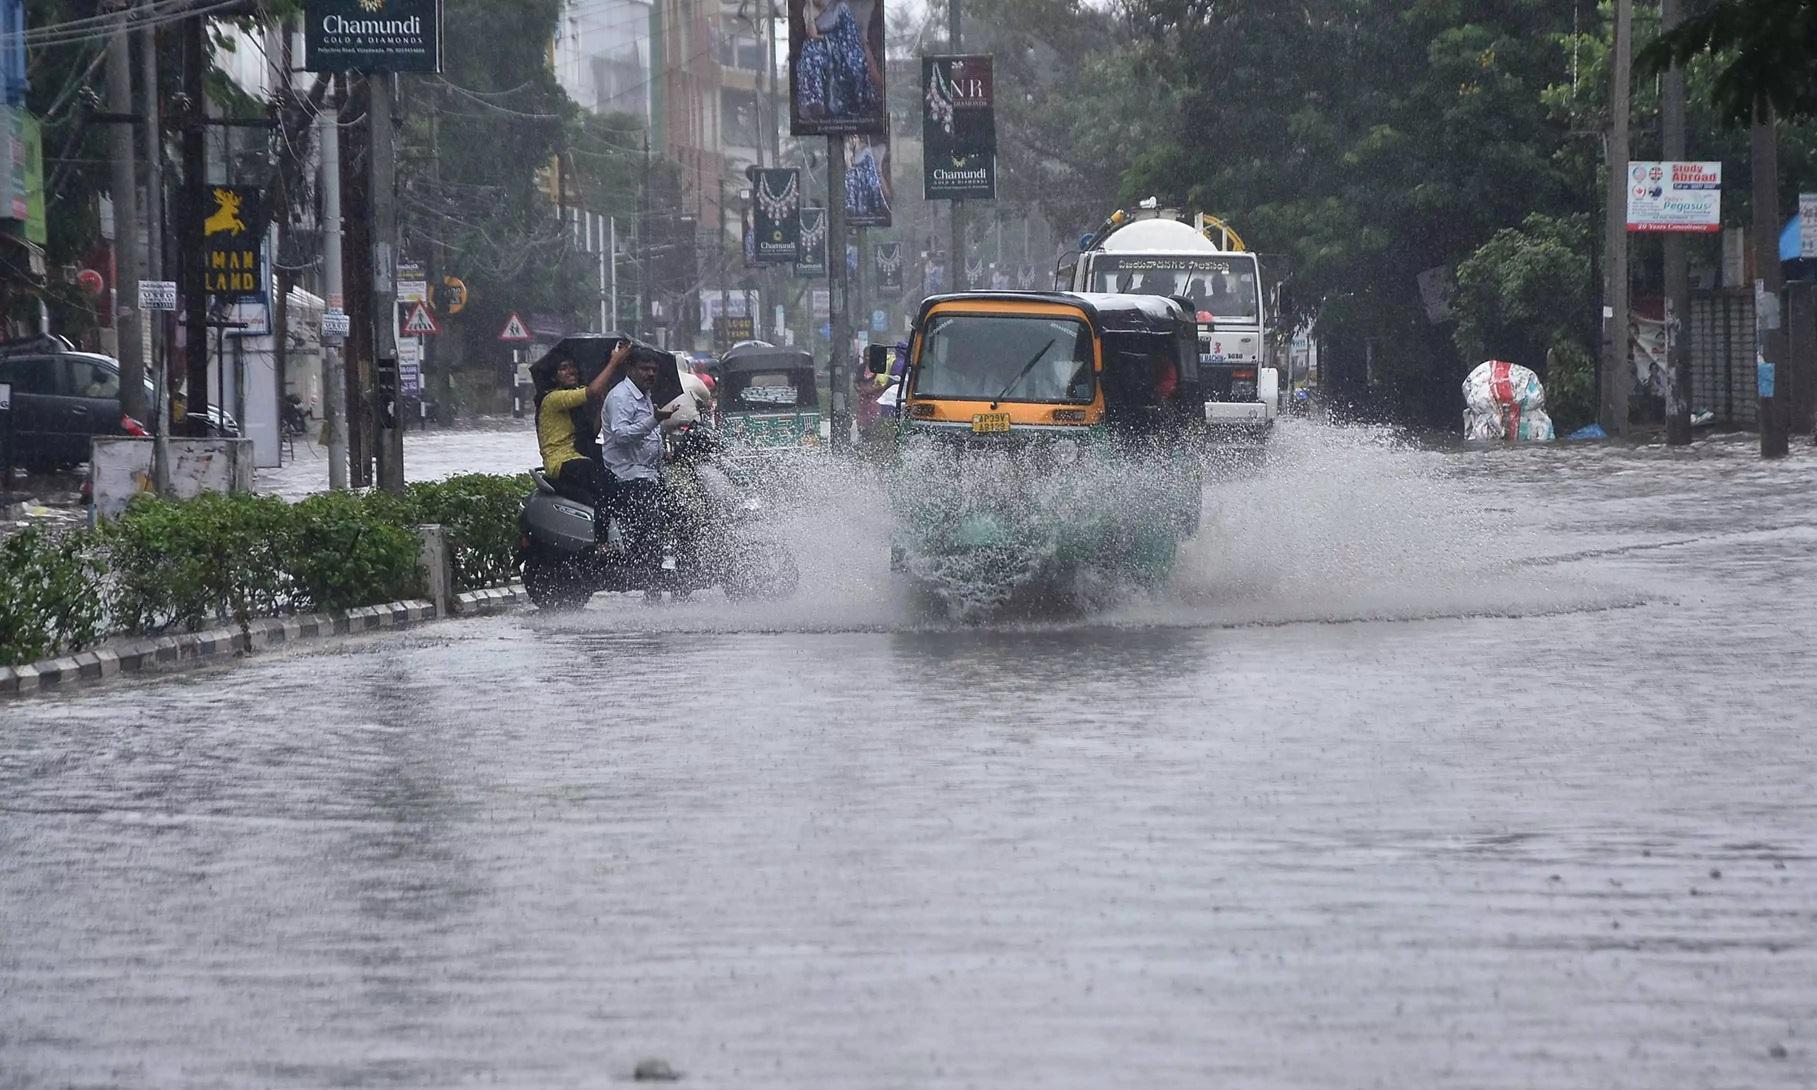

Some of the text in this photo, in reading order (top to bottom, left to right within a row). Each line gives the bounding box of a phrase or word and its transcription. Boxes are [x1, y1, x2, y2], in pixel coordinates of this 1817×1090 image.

[323, 15, 420, 34] Chamundi
[1672, 164, 1703, 173] Study
[933, 168, 987, 180] Chamundi
[1672, 172, 1717, 182] Abroad
[1663, 202, 1709, 212] Pegasus
[760, 241, 796, 250] Chamundi
[205, 272, 254, 290] LAND
